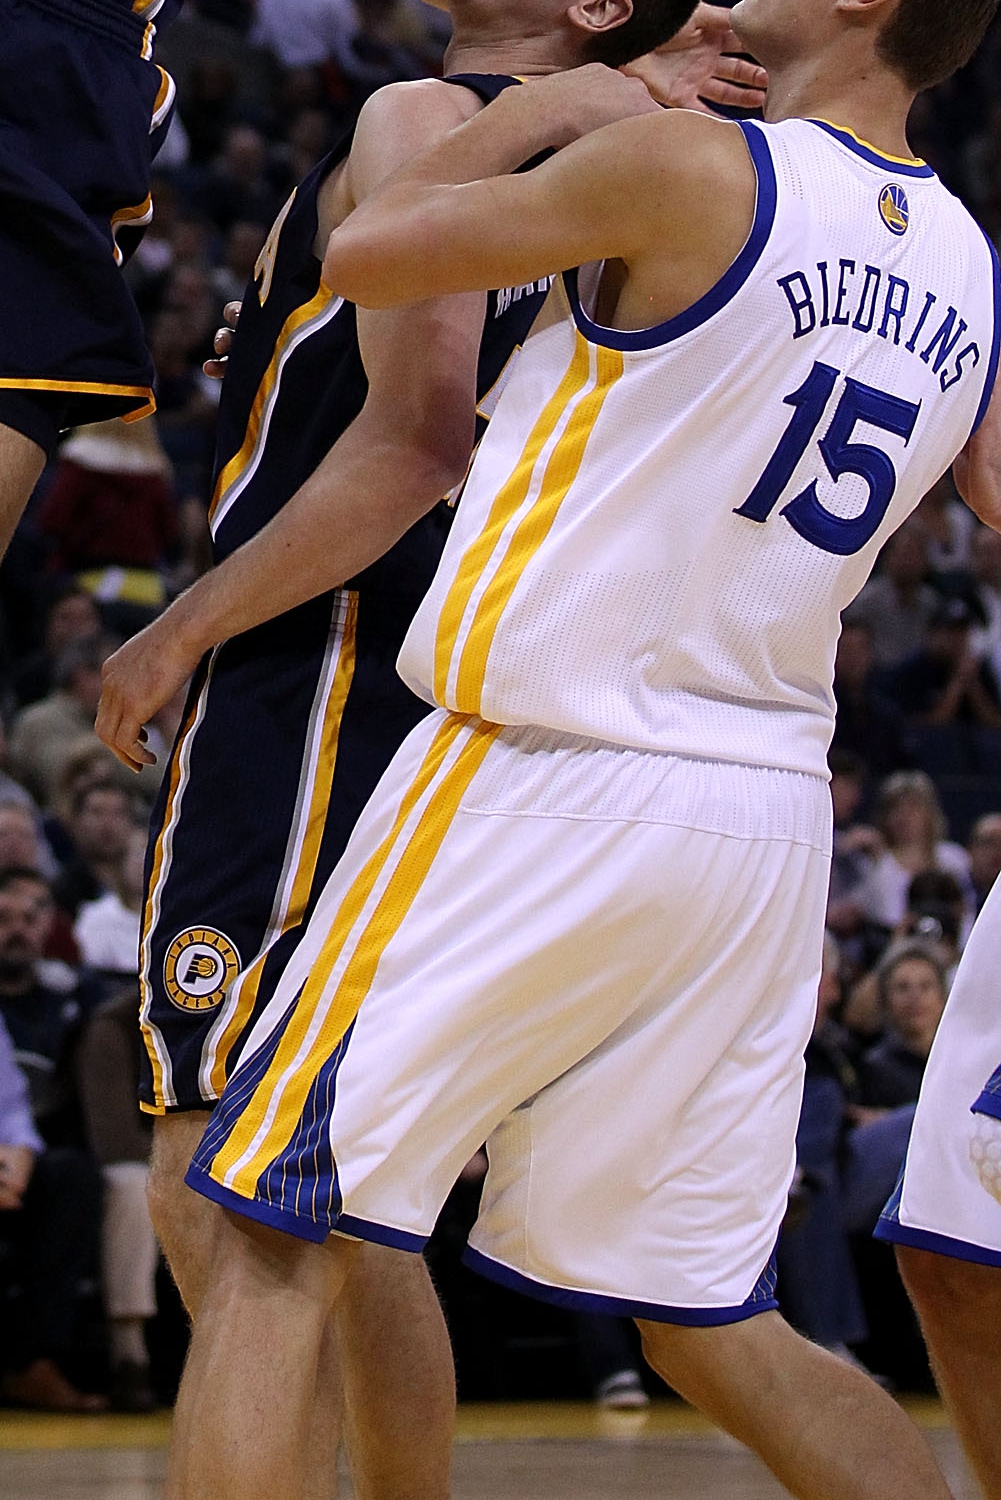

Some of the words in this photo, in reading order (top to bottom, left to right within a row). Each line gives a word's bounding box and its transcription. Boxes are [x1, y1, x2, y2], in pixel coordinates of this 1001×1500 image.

[777, 259, 980, 393] BIEDRINS
[732, 361, 922, 556] 15
[167, 977, 226, 1008] PACERS
[170, 932, 237, 969] INDIANA
